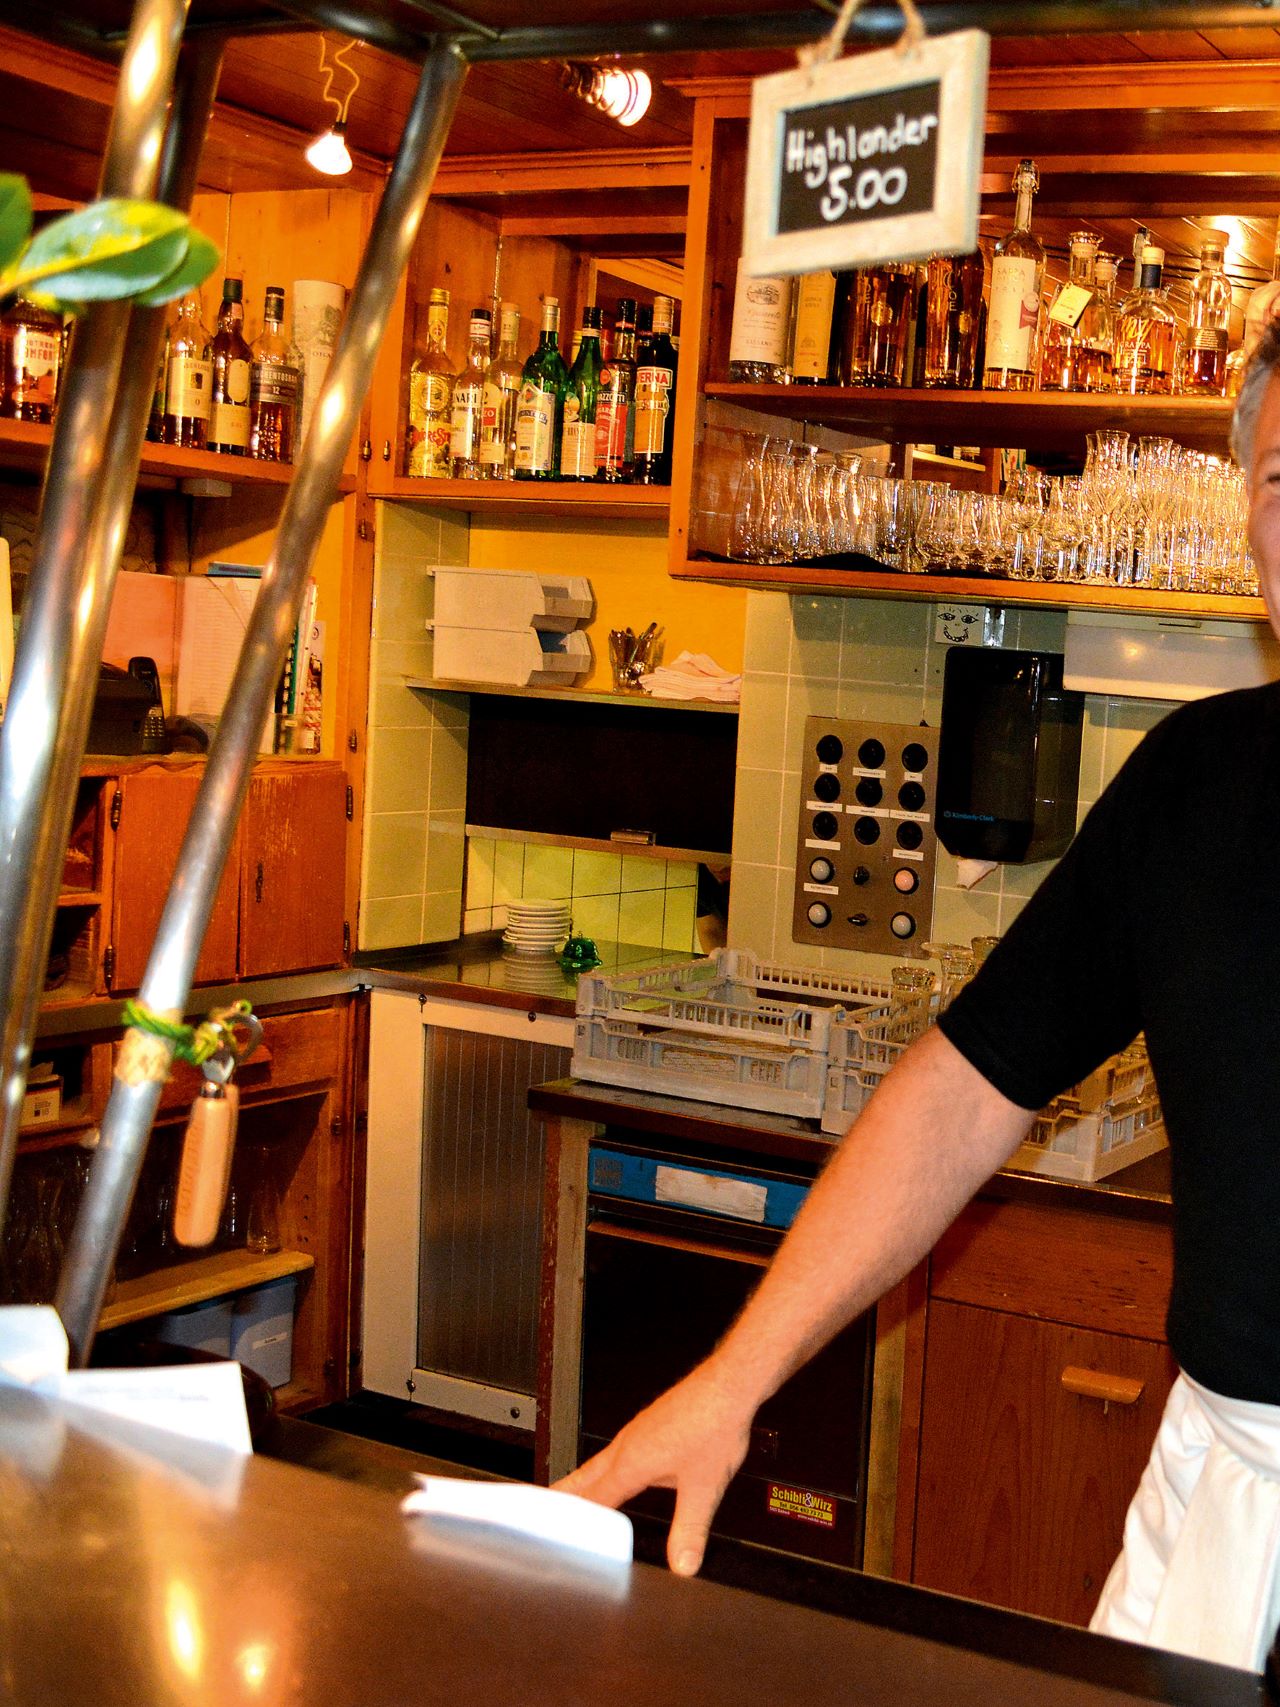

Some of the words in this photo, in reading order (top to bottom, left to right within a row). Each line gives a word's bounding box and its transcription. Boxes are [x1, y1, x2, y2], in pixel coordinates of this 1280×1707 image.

[786, 113, 938, 189] Highlander
[820, 164, 908, 222] 5.00
[272, 386, 280, 395] 12
[636, 372, 669, 385] ERNA
